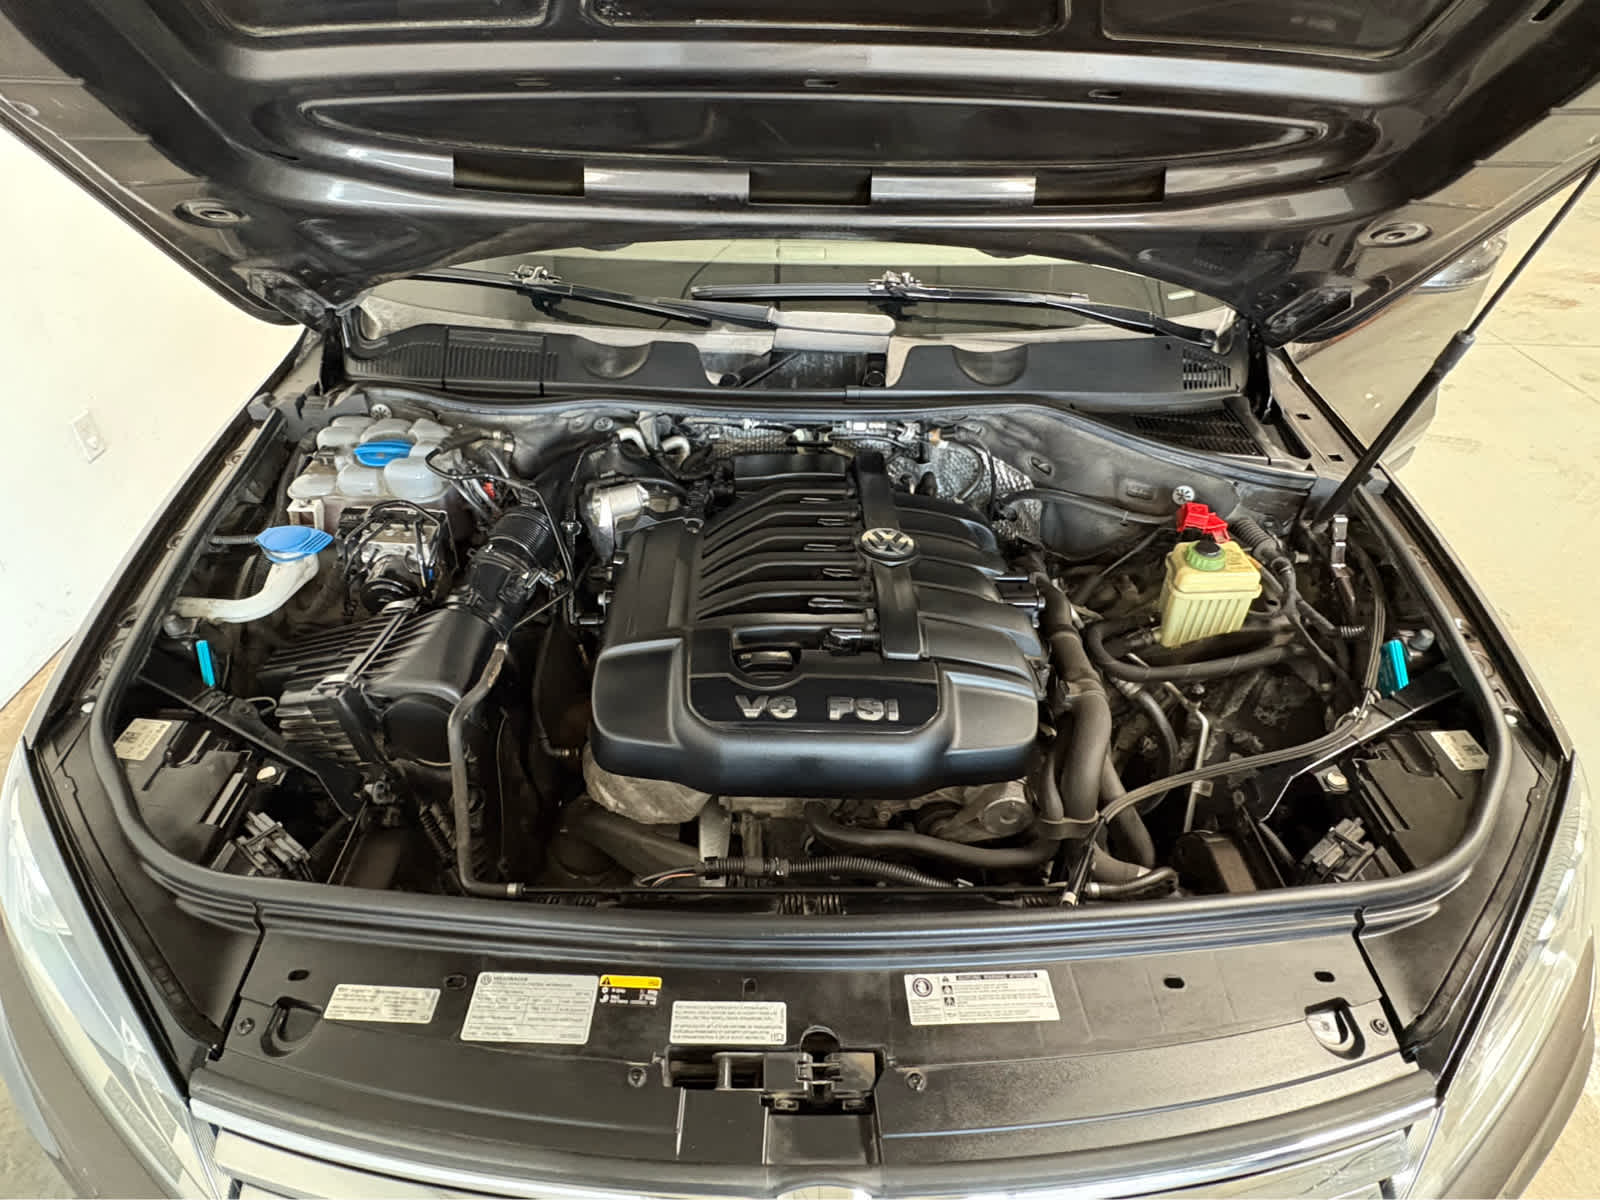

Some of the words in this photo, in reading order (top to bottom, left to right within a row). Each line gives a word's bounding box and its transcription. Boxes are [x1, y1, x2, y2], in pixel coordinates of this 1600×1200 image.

[861, 527, 914, 556] VW
[735, 695, 798, 719] V6
[828, 696, 899, 721] FSI
